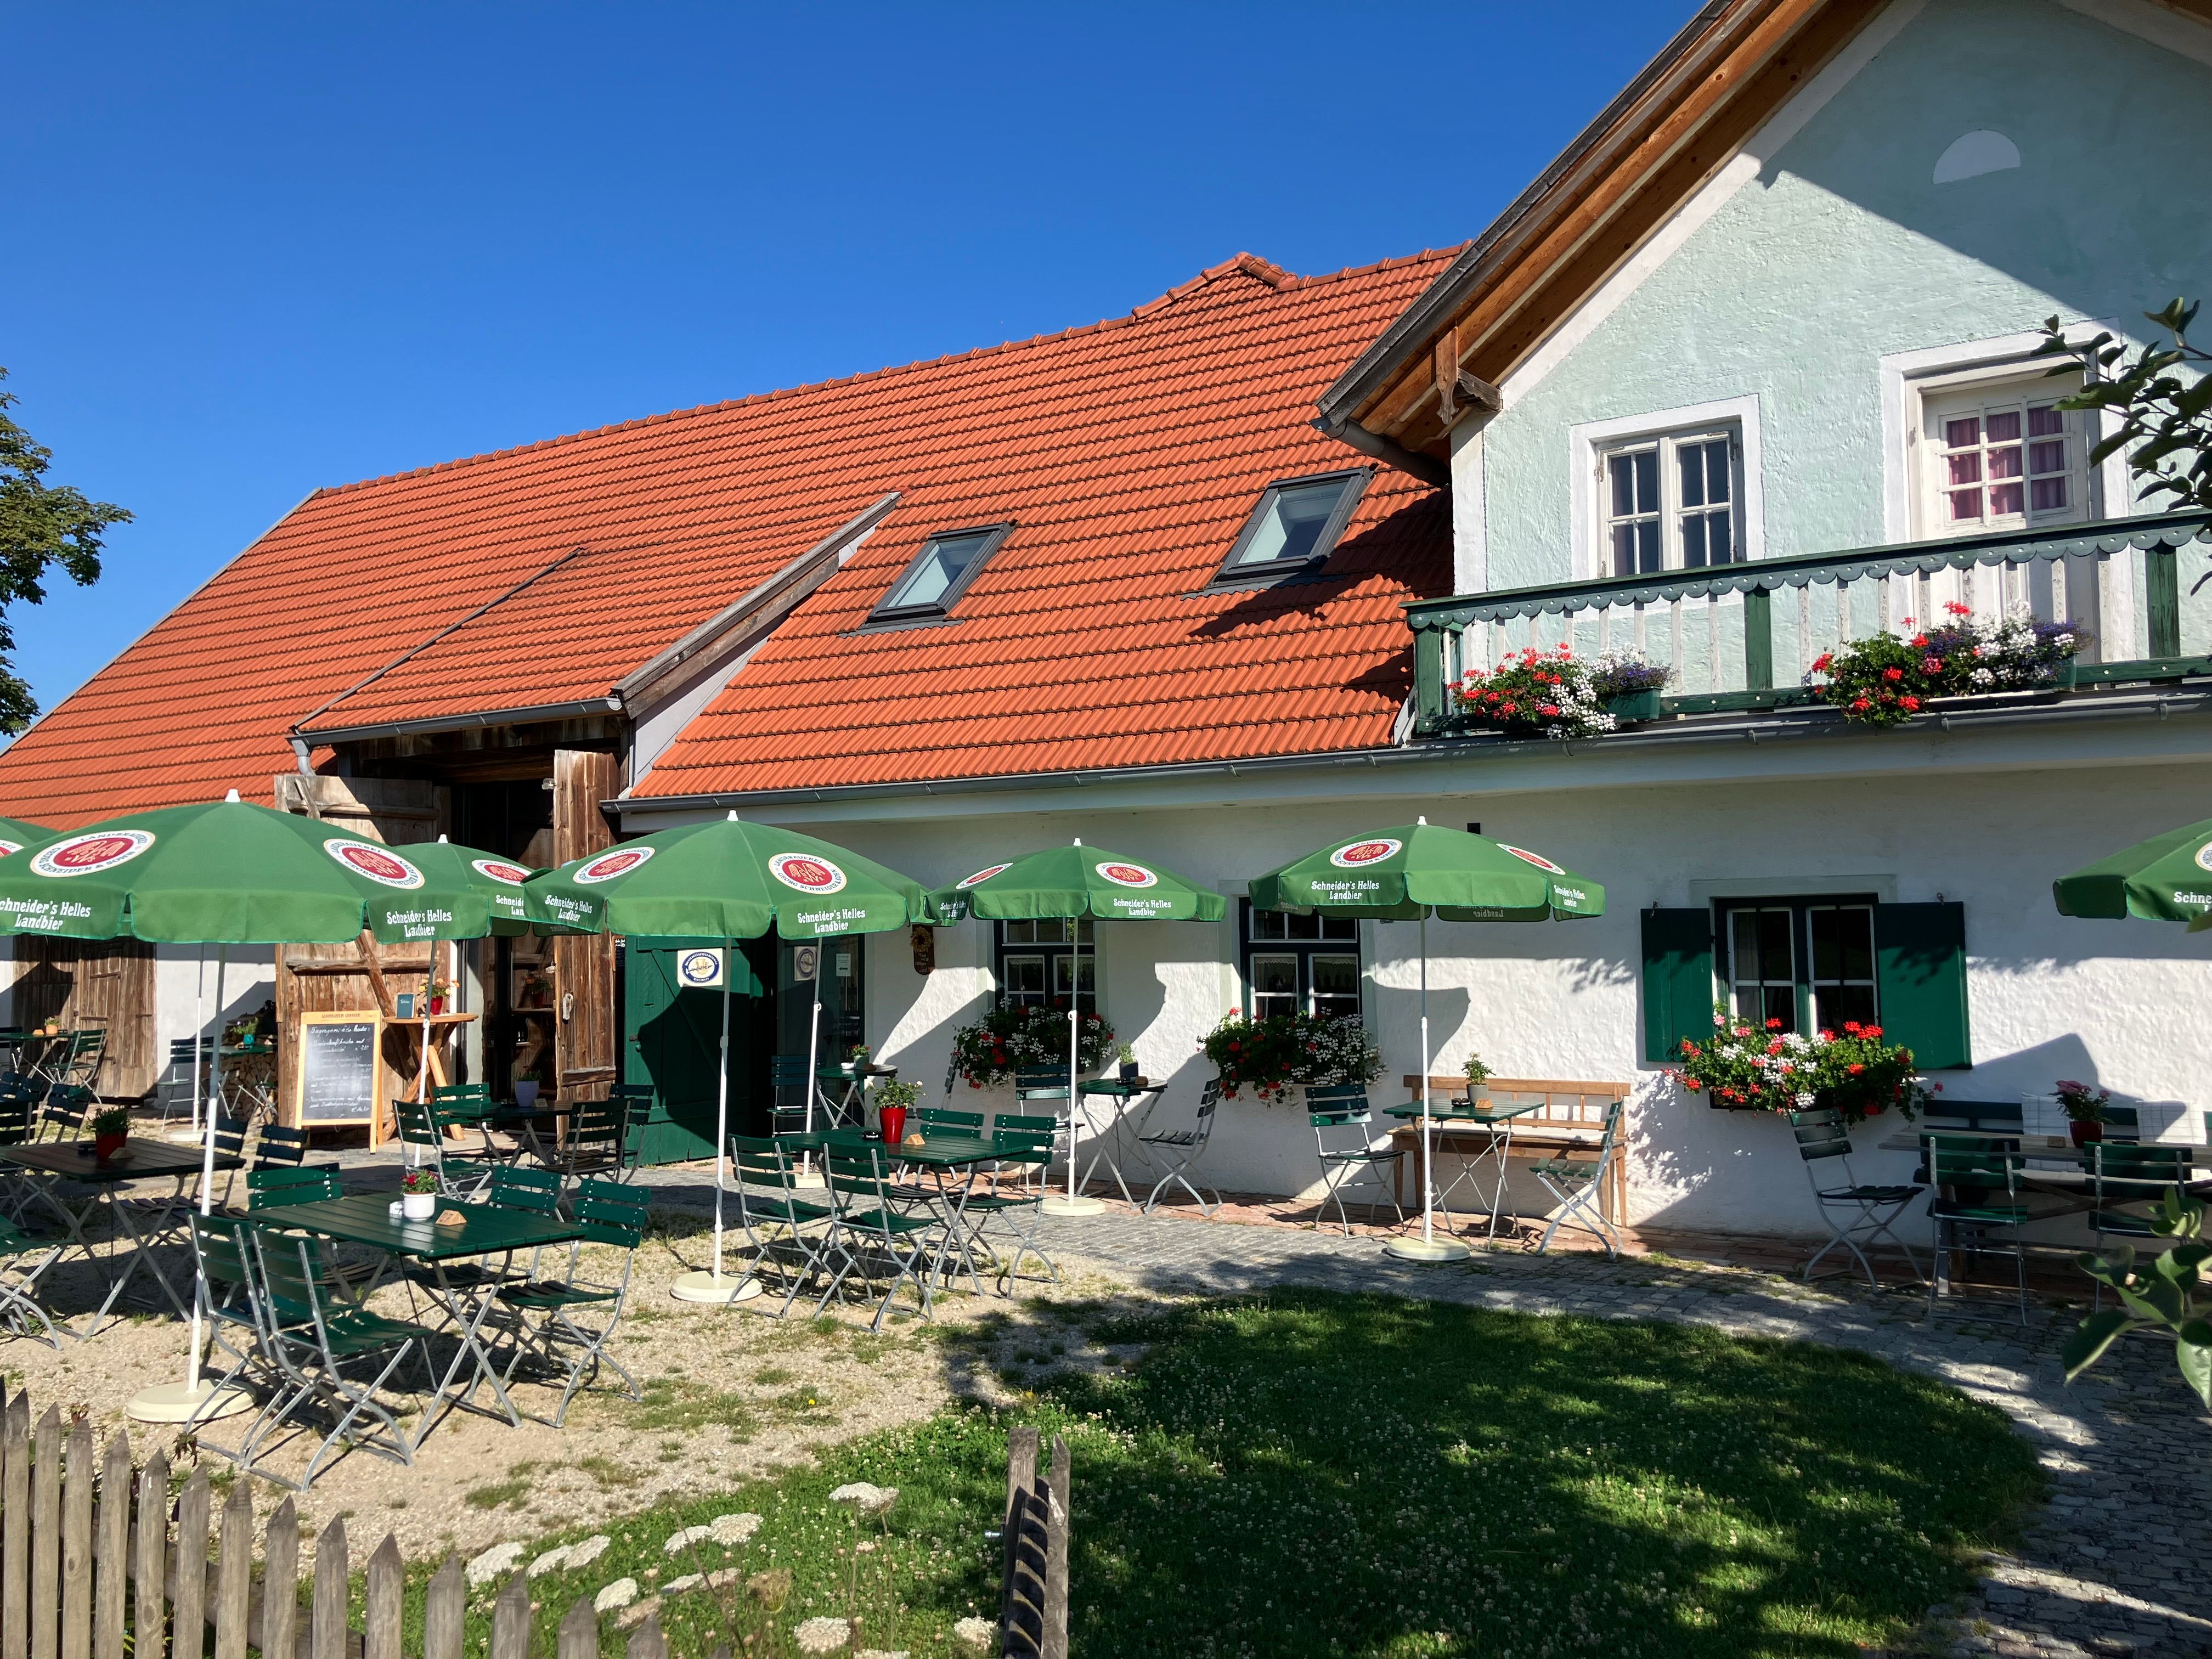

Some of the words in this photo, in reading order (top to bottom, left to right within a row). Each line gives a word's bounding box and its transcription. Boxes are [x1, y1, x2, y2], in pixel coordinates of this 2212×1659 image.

[774, 855, 823, 866] LANDBRAUEREI
[39, 864, 92, 873] SCHNEIDER
[778, 873, 798, 887] GEORG
[800, 883, 839, 891] SCHNEIDER
[1311, 881, 1356, 890] Schneider's
[1357, 881, 1379, 890] Helles
[1329, 891, 1362, 900] Landbier
[0, 897, 58, 915] chneider's
[60, 901, 91, 917] Helles
[545, 895, 579, 910] Schneider's
[579, 900, 592, 913] Helles
[1113, 898, 1149, 908] Schneider's
[1151, 900, 1172, 908] Helles
[386, 910, 426, 924] Schneider's
[427, 909, 452, 922] Helles
[797, 909, 841, 923] Schneider's
[842, 908, 866, 919] Helles
[1128, 907, 1156, 916] Landbier
[15, 914, 64, 930] Landbier
[815, 920, 849, 933] Landbier
